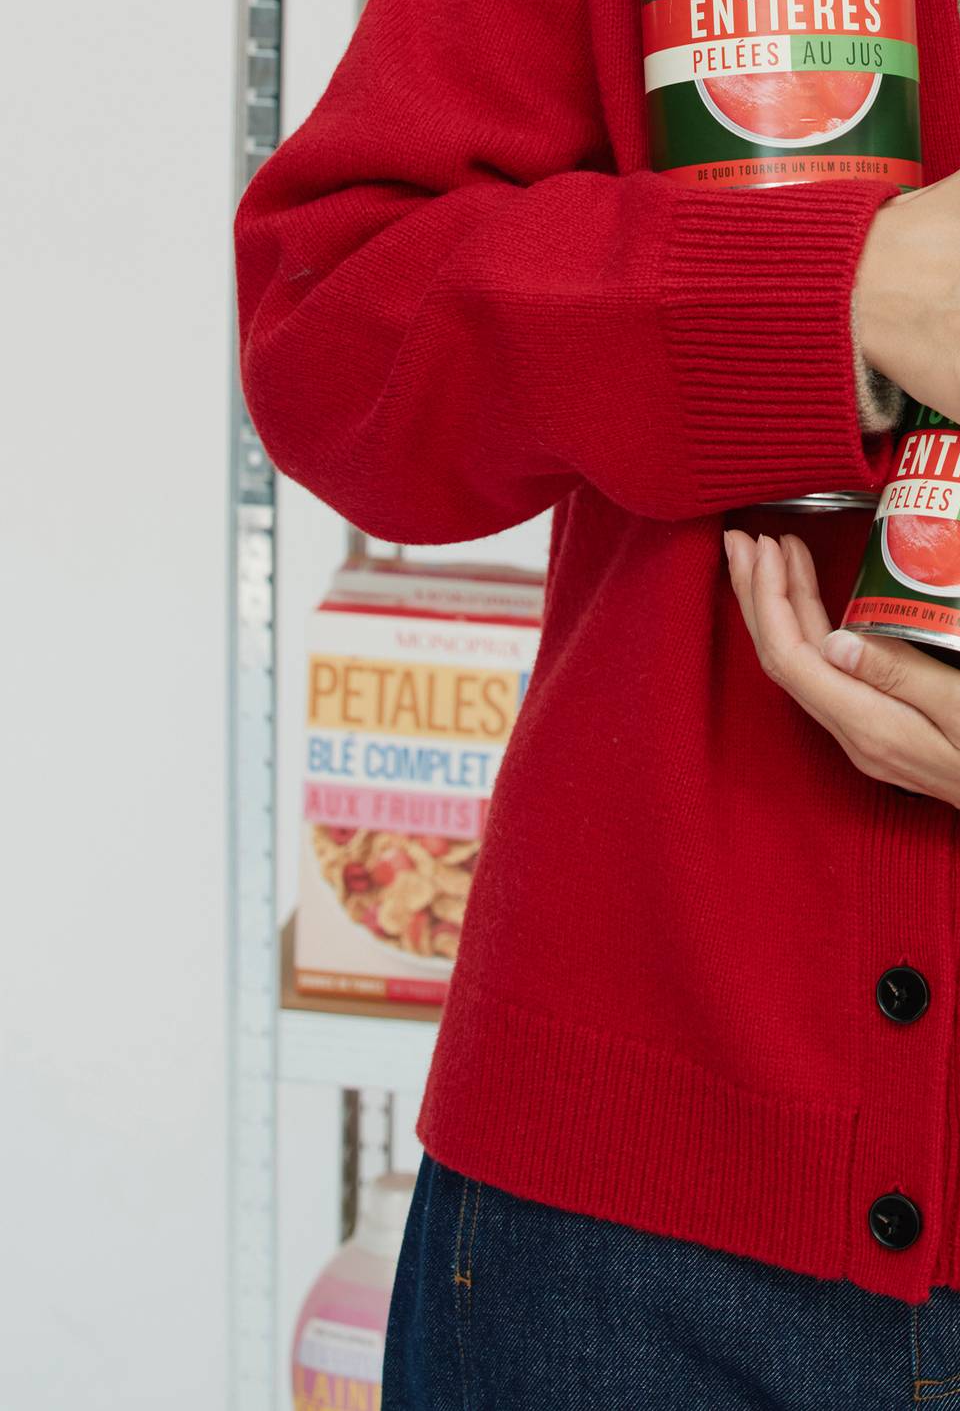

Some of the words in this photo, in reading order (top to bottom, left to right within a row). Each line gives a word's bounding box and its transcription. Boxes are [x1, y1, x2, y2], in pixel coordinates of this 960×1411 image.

[693, 39, 780, 73] PELÉES
[803, 41, 832, 66] AU
[846, 42, 883, 67] JUS
[698, 169, 708, 181] DE
[712, 166, 735, 180] QUOI
[740, 162, 787, 176] TOURNER
[792, 161, 805, 173] UN
[811, 161, 835, 172] FILM
[840, 161, 851, 172] DE
[856, 160, 880, 174] SÉRIE
[883, 163, 889, 174] B
[887, 480, 952, 511] PELÉES
[879, 602, 918, 617] TOURNER
[922, 607, 935, 621] UN
[309, 655, 507, 739] PÉTALES
[307, 731, 356, 777] BLÉ
[364, 741, 490, 787] COMPLET
[305, 789, 363, 820] AUX
[373, 793, 472, 831] FRUITS
